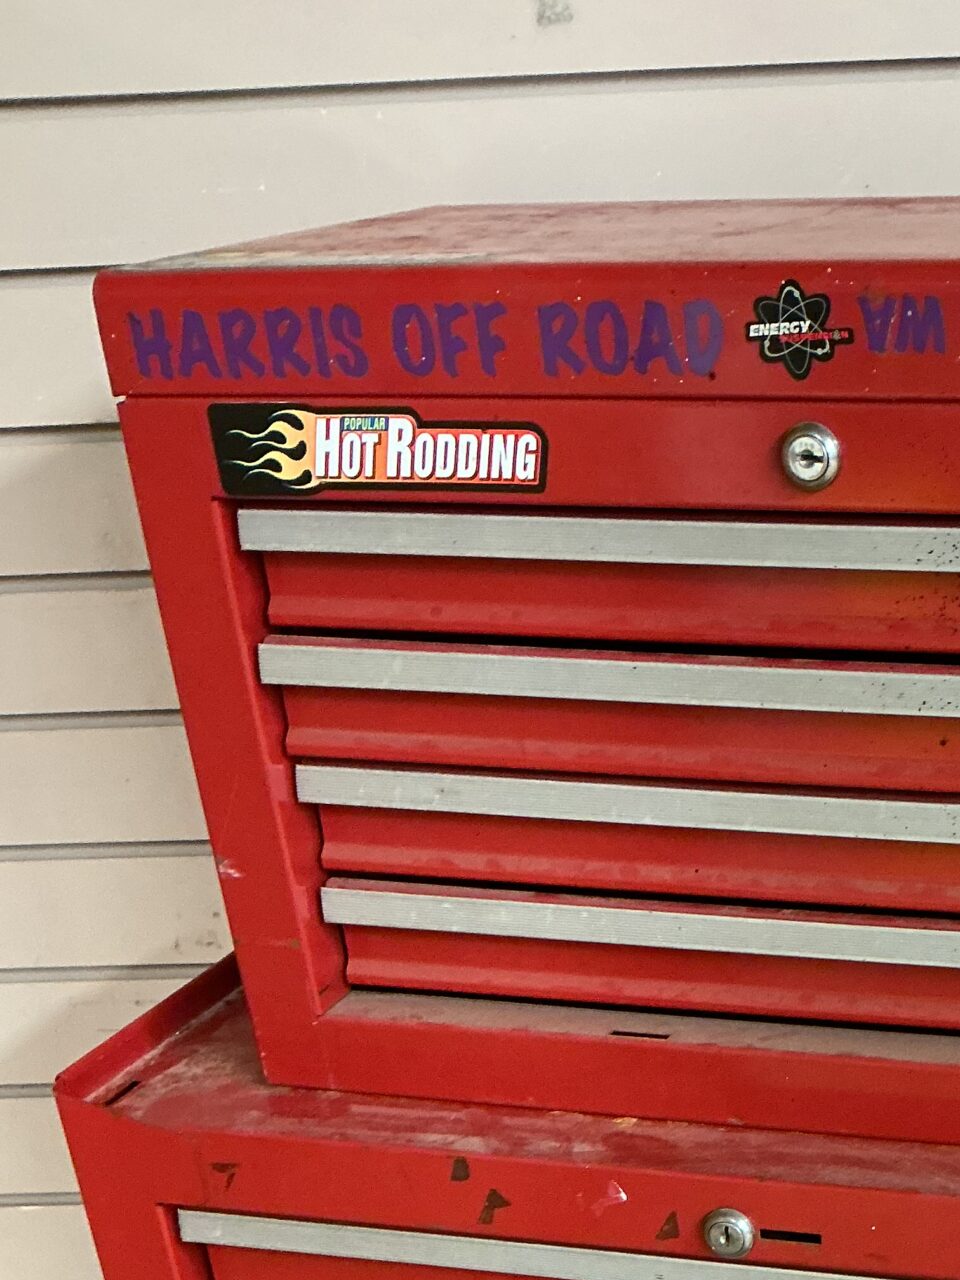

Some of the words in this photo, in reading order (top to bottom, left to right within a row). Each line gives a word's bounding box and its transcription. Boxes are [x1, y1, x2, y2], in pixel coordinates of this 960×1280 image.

[129, 304, 370, 381] HARRIS
[392, 303, 507, 378] OFF
[537, 299, 724, 377] ROAD
[749, 320, 811, 337] ENERGY
[858, 293, 946, 354] WA
[315, 417, 381, 478] HOT
[386, 417, 538, 481] RODDING
[344, 417, 386, 431] POPULAR
